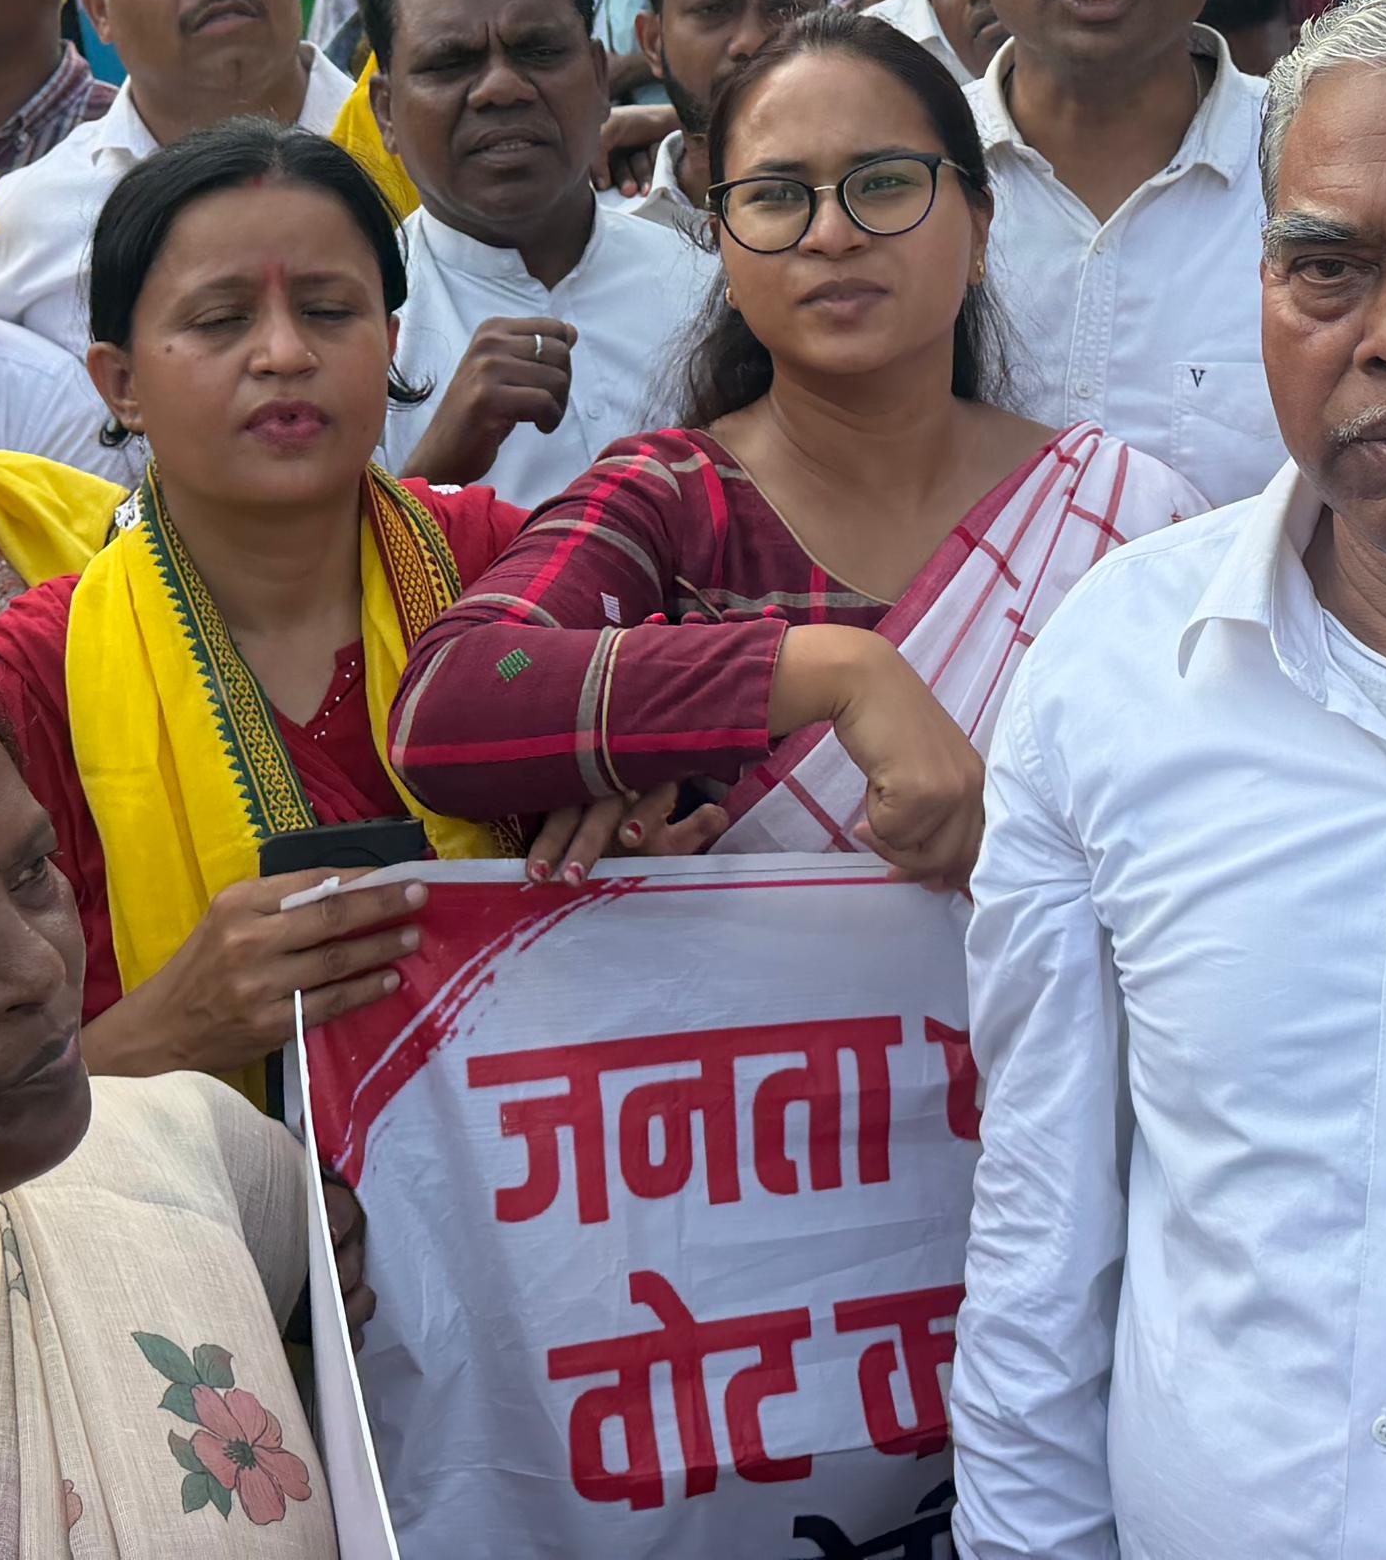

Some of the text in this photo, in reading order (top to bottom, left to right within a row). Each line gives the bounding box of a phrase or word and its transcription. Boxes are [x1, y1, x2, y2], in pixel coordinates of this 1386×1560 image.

[1188, 368, 1207, 388] V
[466, 1015, 903, 1226] जनता
[547, 1269, 813, 1511] वोट
